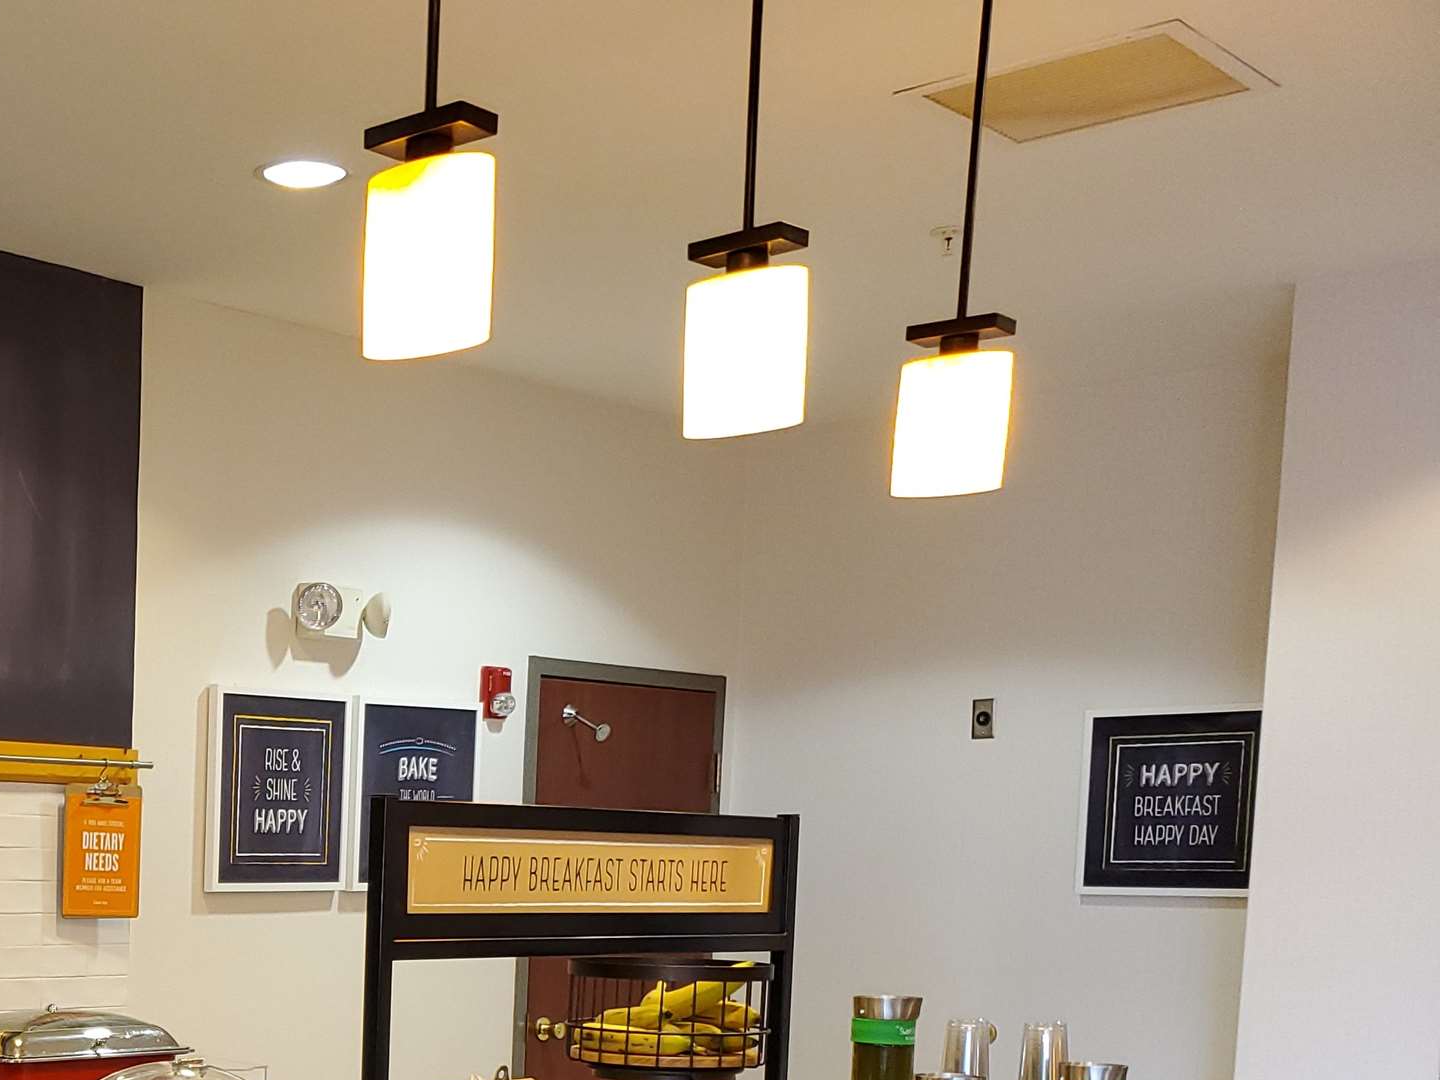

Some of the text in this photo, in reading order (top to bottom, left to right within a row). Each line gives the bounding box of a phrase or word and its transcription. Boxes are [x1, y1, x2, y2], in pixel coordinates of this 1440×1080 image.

[265, 748, 301, 772] RISE &
[398, 756, 439, 781] BAKE
[1140, 762, 1220, 787] HAPPY
[266, 778, 298, 801] SHINE
[400, 788, 411, 801] THE
[1134, 794, 1222, 817] BREAKFAST
[253, 808, 308, 834] HAPPY
[82, 831, 125, 851] DIETARY
[1134, 824, 1219, 846] HAPPY DAY
[85, 853, 120, 872] NEEDS
[462, 855, 729, 893] HAPPY BREAKFAST STARTS HERE
